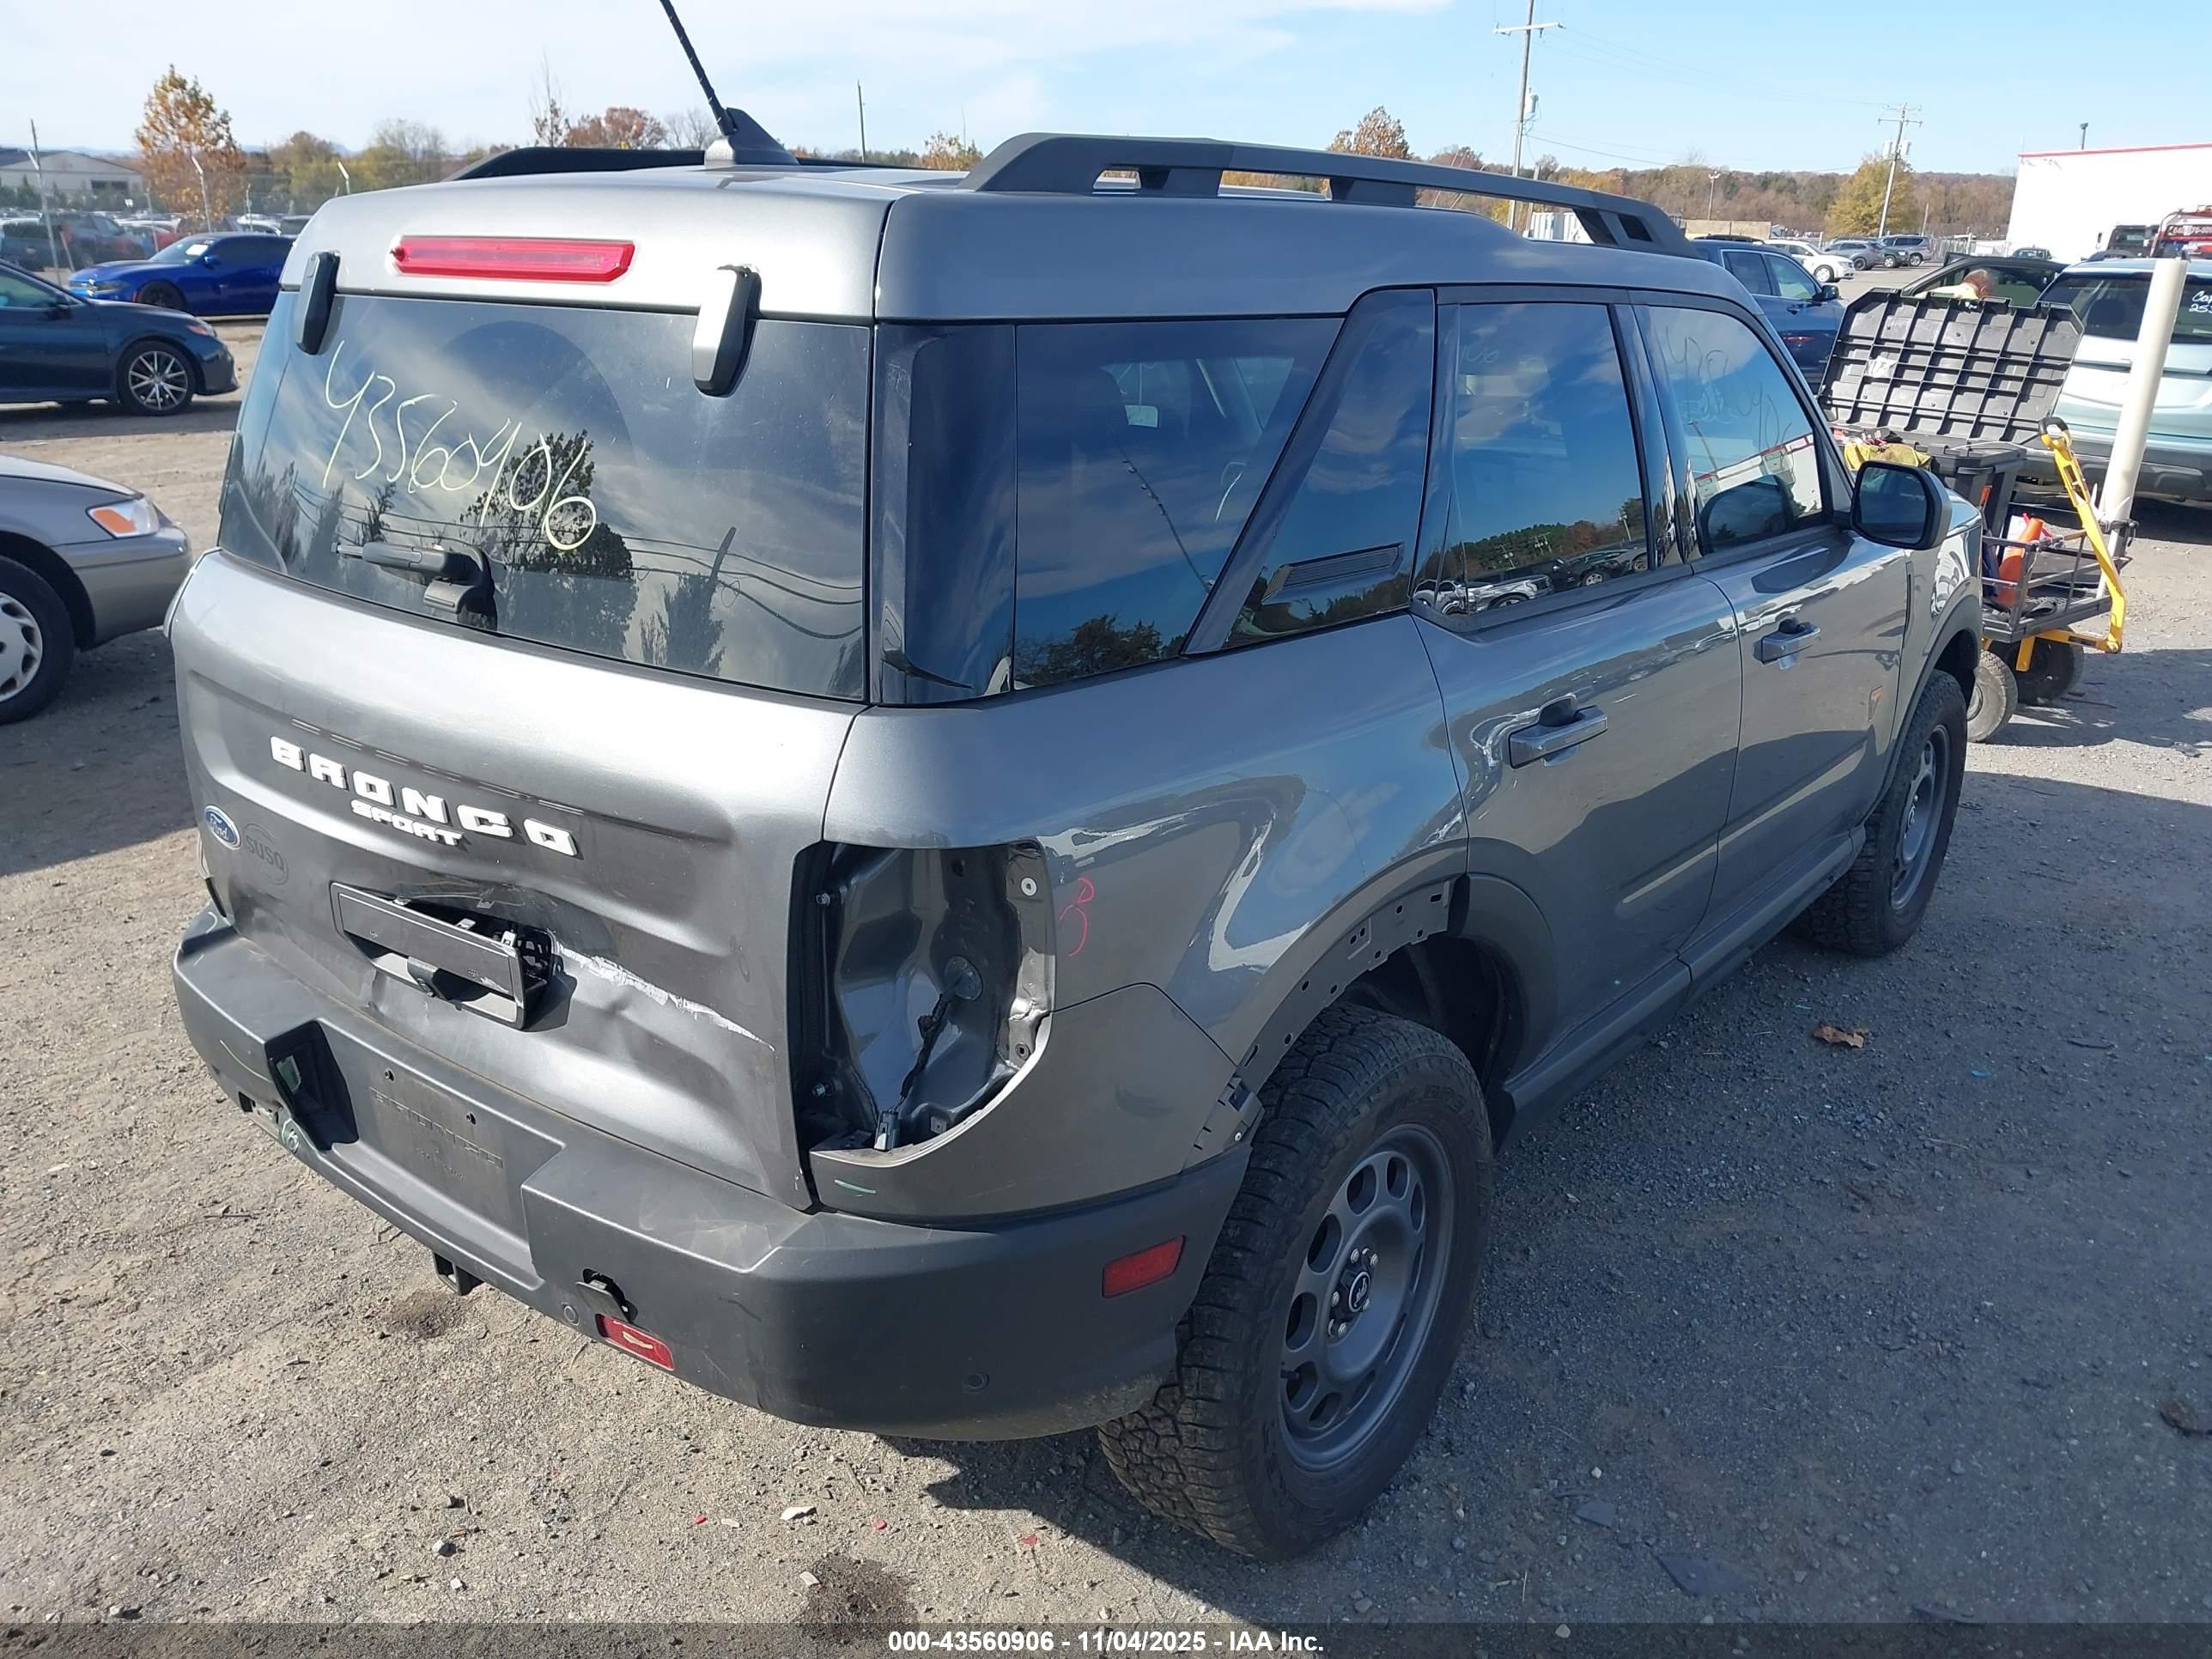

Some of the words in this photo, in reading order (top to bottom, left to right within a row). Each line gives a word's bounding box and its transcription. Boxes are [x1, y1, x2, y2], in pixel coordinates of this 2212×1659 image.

[322, 340, 597, 551] 43560906
[270, 735, 579, 857] BRONCO
[350, 799, 463, 846] SPORT
